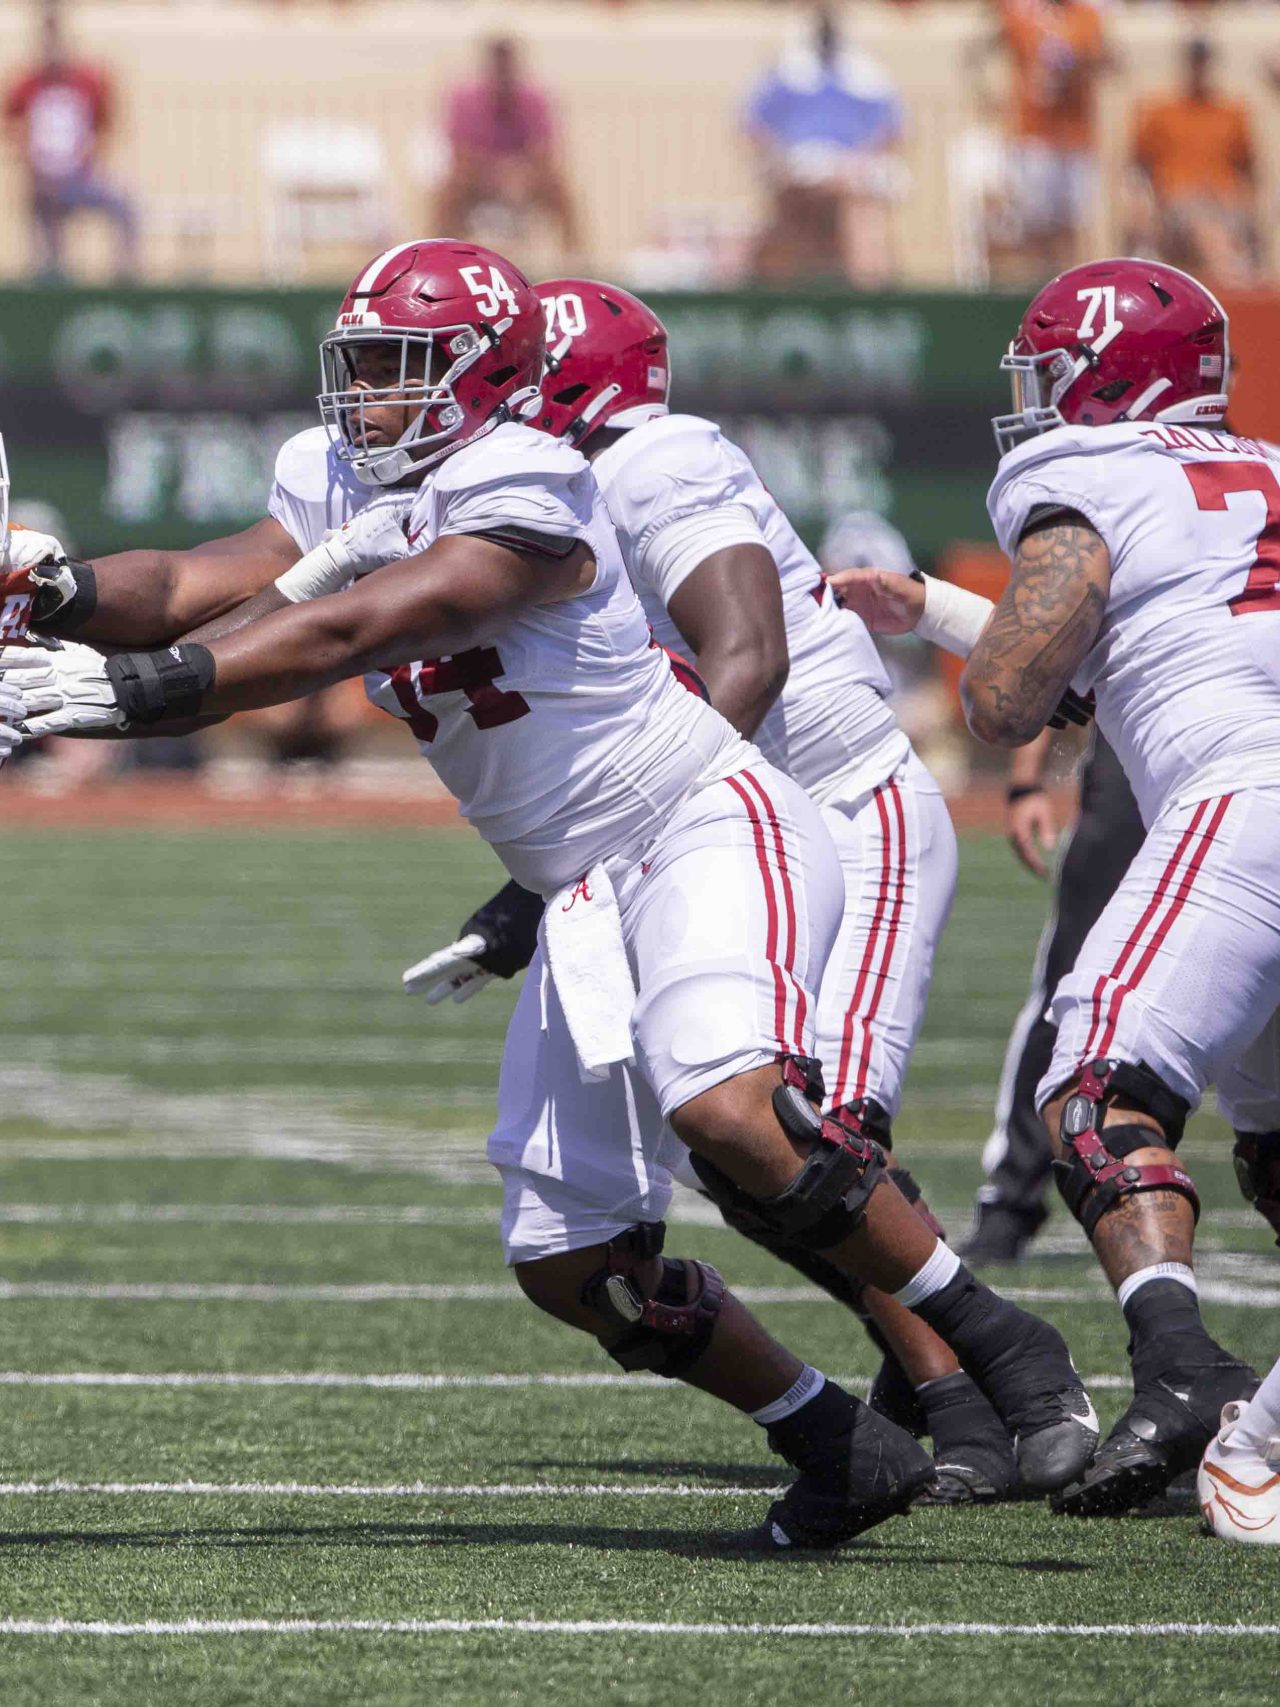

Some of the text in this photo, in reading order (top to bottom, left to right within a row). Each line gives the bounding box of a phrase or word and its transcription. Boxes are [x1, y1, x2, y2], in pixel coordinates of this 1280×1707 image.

[458, 265, 520, 317] 54
[1077, 285, 1116, 339] 71
[540, 293, 587, 343] 70
